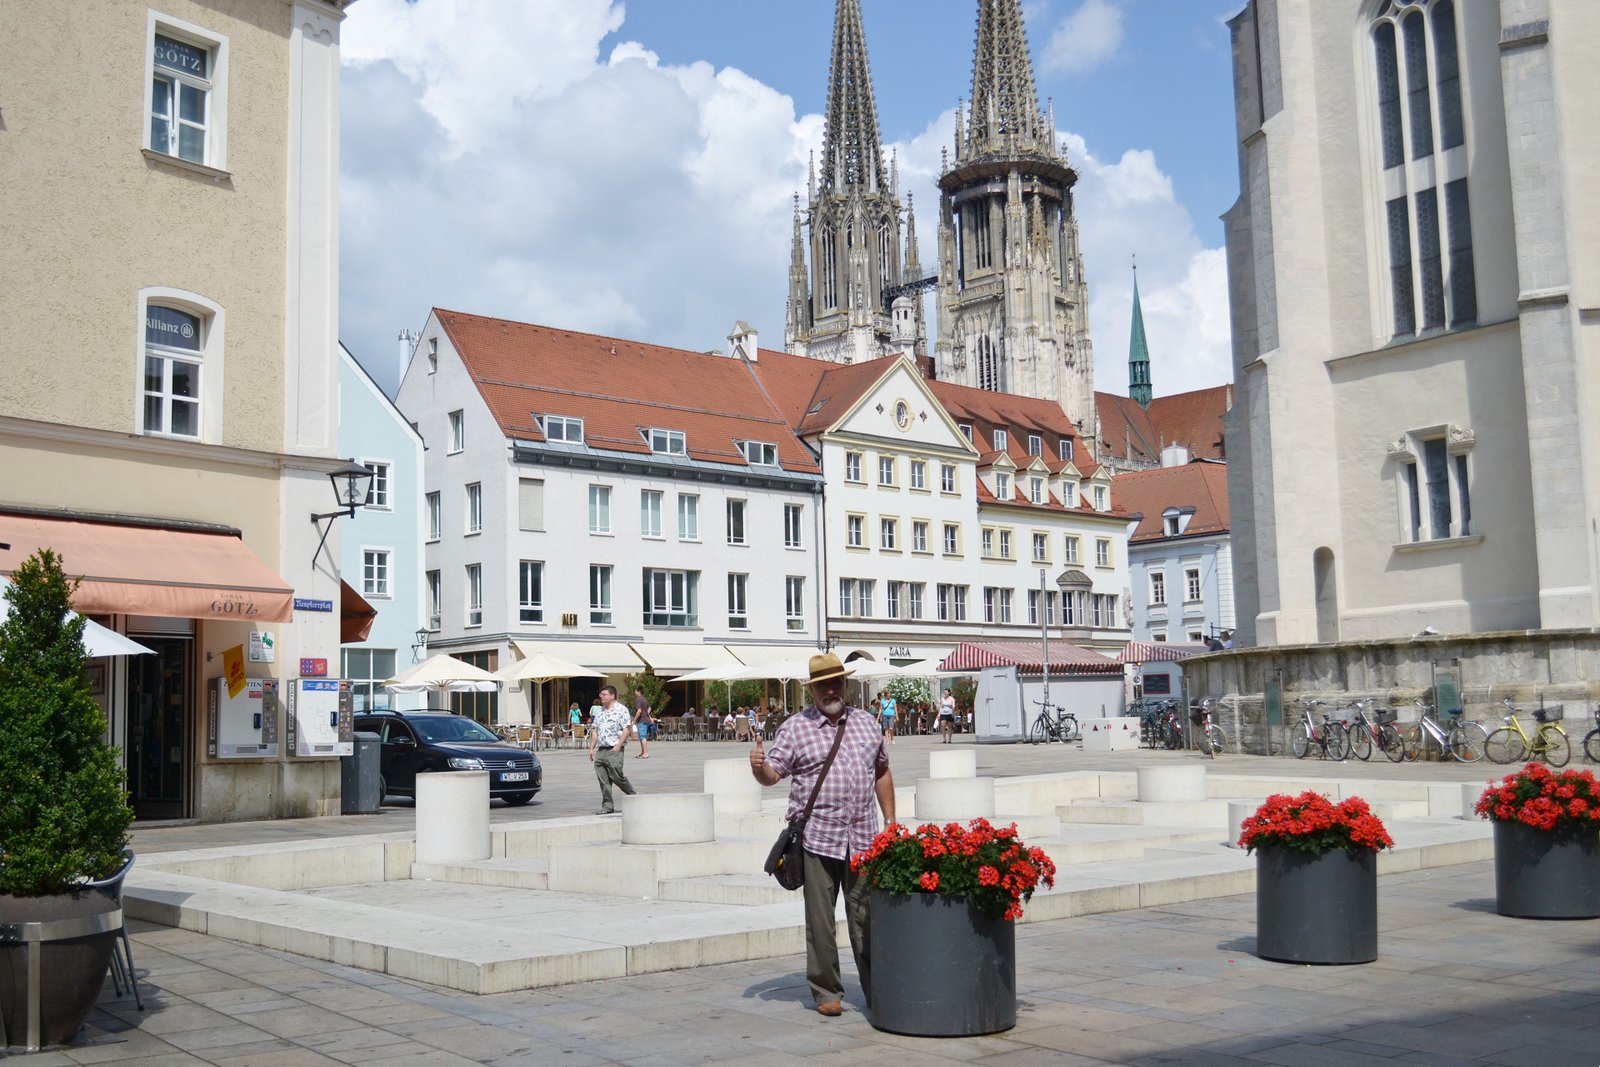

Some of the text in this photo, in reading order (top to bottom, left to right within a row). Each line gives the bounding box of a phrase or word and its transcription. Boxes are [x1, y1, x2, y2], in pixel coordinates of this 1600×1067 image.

[154, 46, 201, 71] GÖTZ
[146, 317, 179, 334] Allianz
[562, 613, 578, 626] ALEX
[889, 646, 911, 657] ZARA
[228, 671, 245, 690] LOTTO
